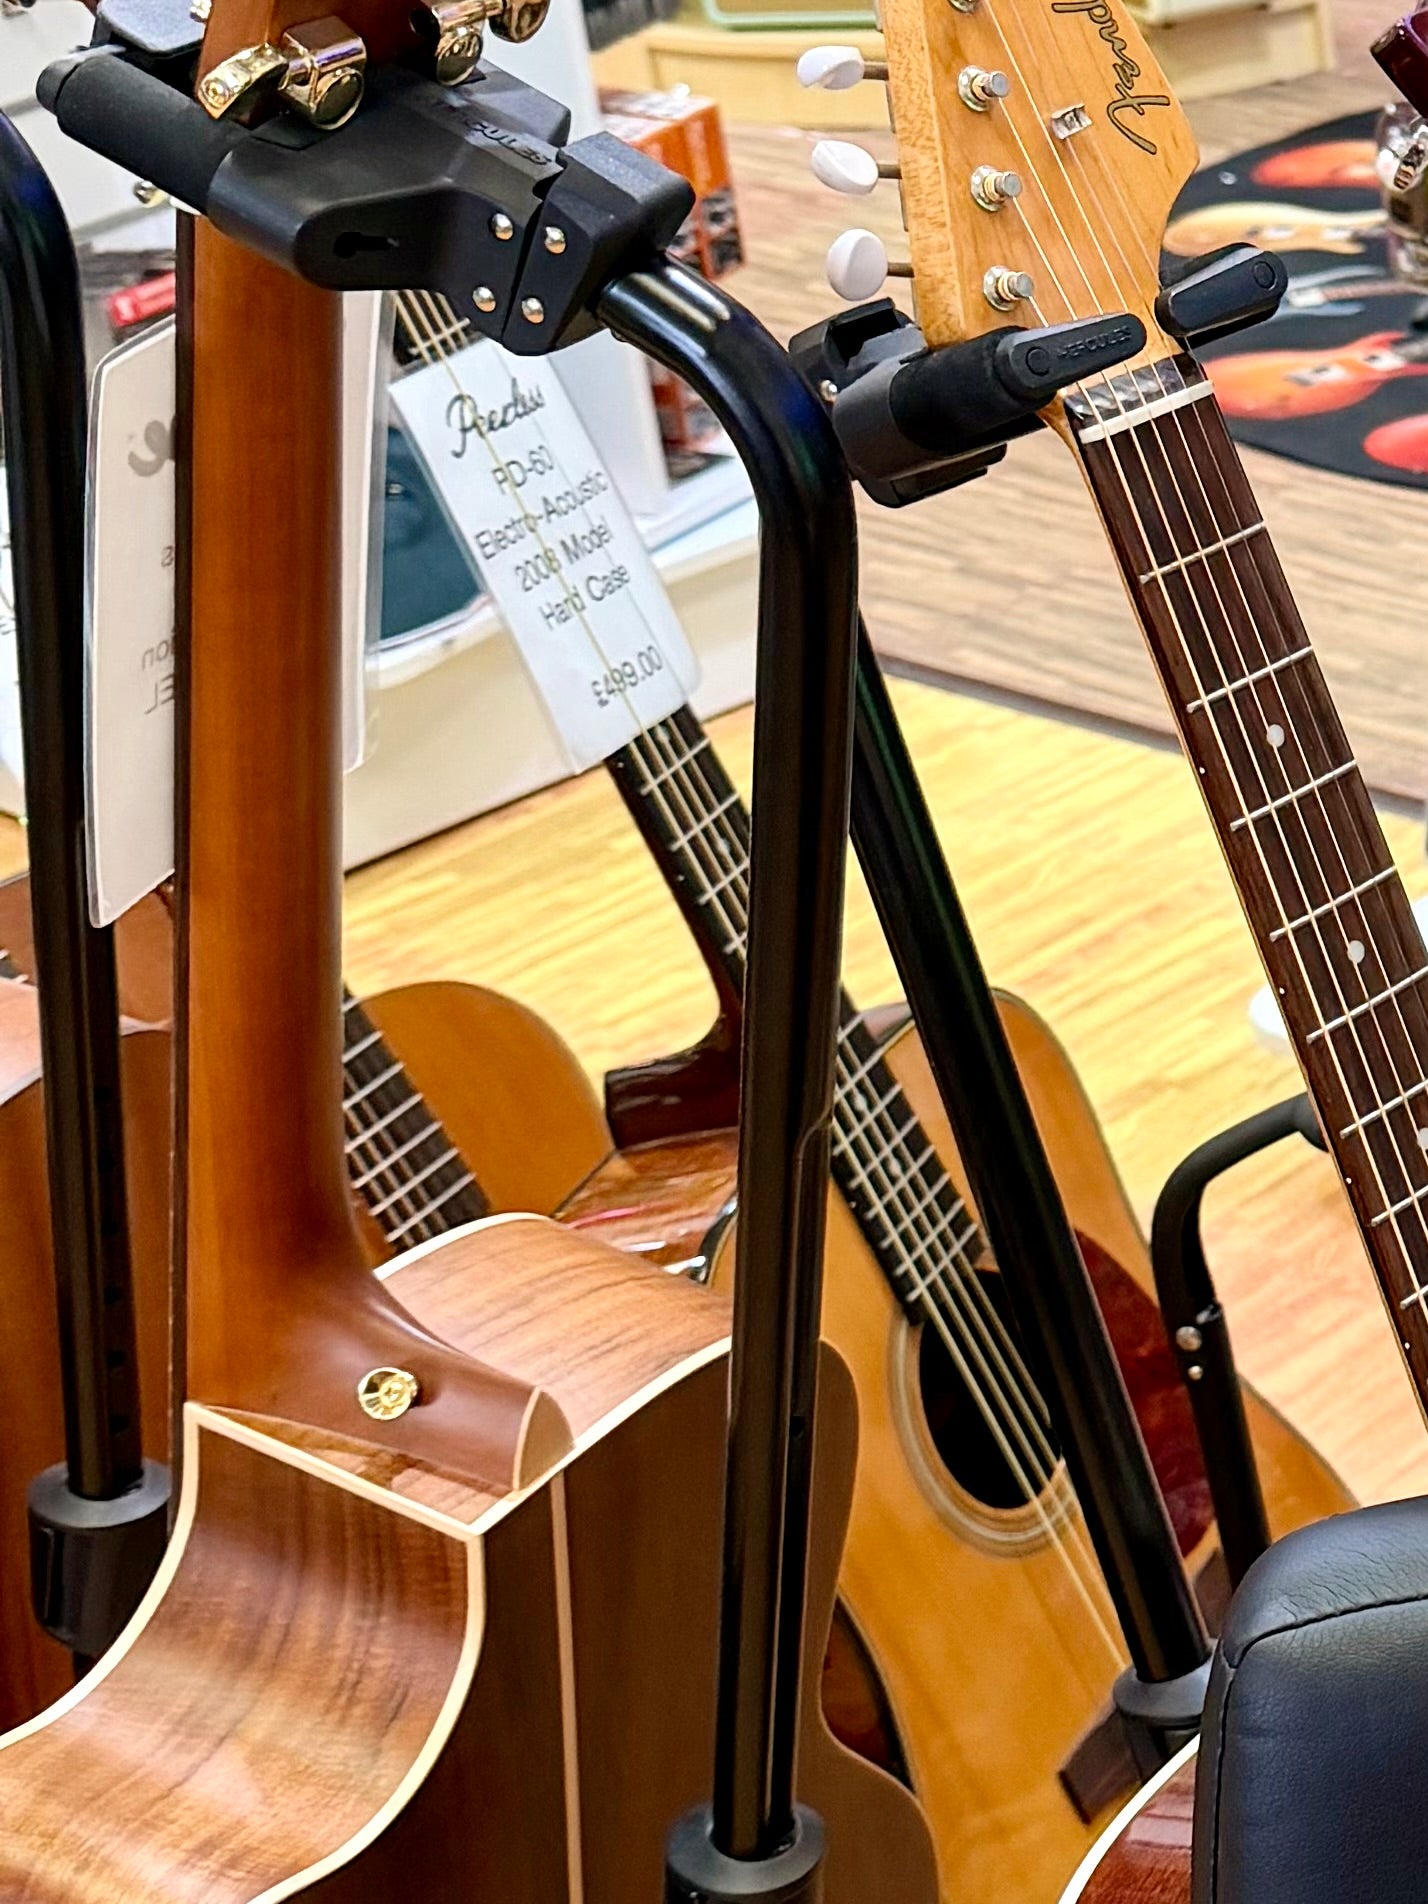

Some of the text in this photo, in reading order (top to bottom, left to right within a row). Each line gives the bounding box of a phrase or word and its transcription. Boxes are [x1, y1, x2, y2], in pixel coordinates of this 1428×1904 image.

[492, 444, 556, 496] PD-60
[476, 468, 611, 561] Electro-Acoustic
[514, 519, 617, 594] 2008 Model
[586, 562, 632, 606] Case
[590, 644, 664, 708] £499.00
